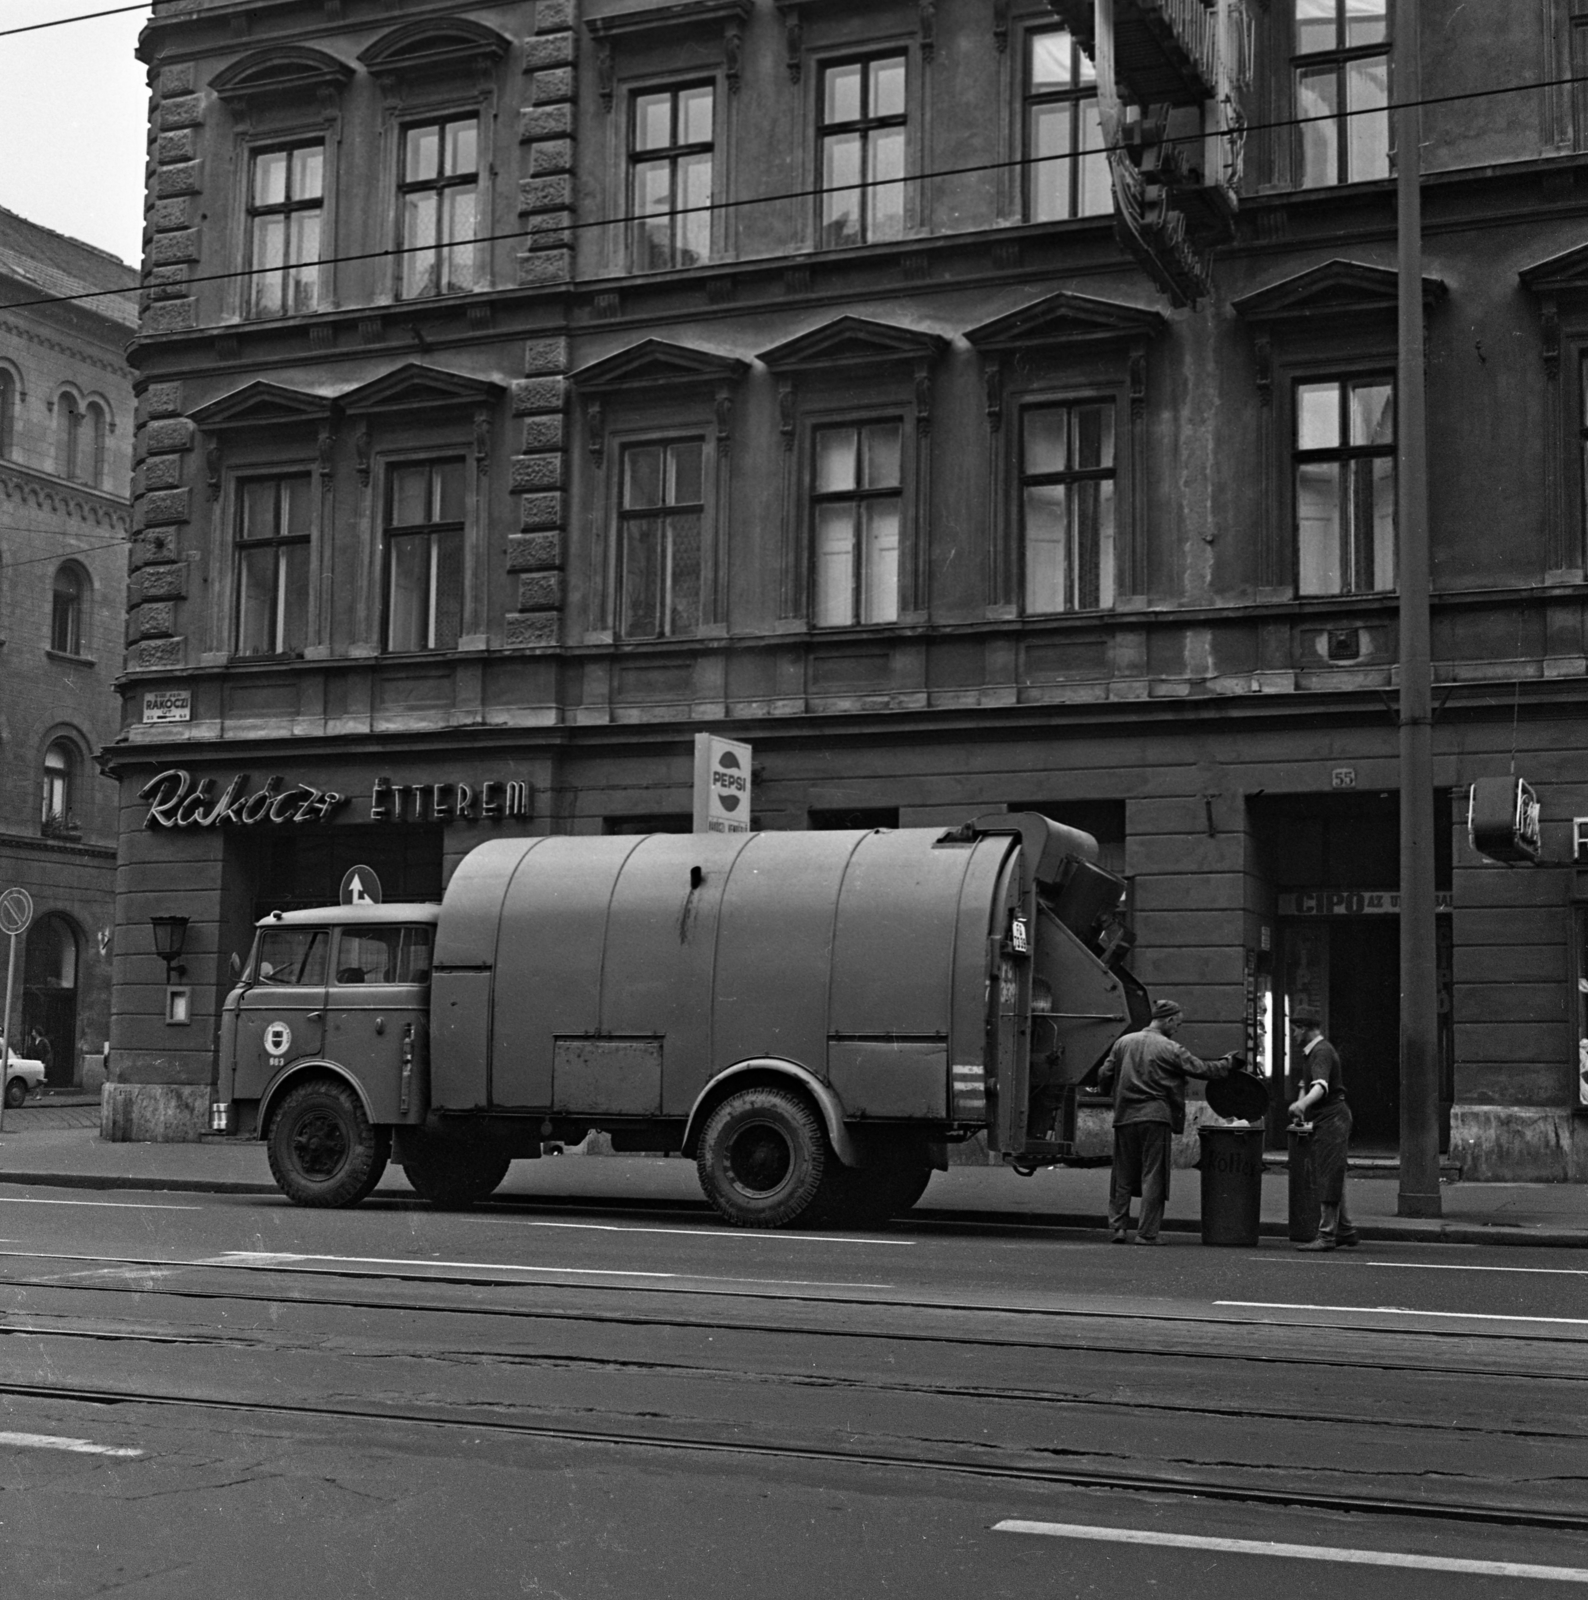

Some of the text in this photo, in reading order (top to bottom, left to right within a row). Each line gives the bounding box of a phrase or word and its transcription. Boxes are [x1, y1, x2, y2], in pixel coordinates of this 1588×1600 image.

[712, 770, 747, 793] PEPSI
[1335, 771, 1353, 786] 55
[371, 778, 529, 820] ÉTTEREM
[1367, 894, 1384, 908] AZ
